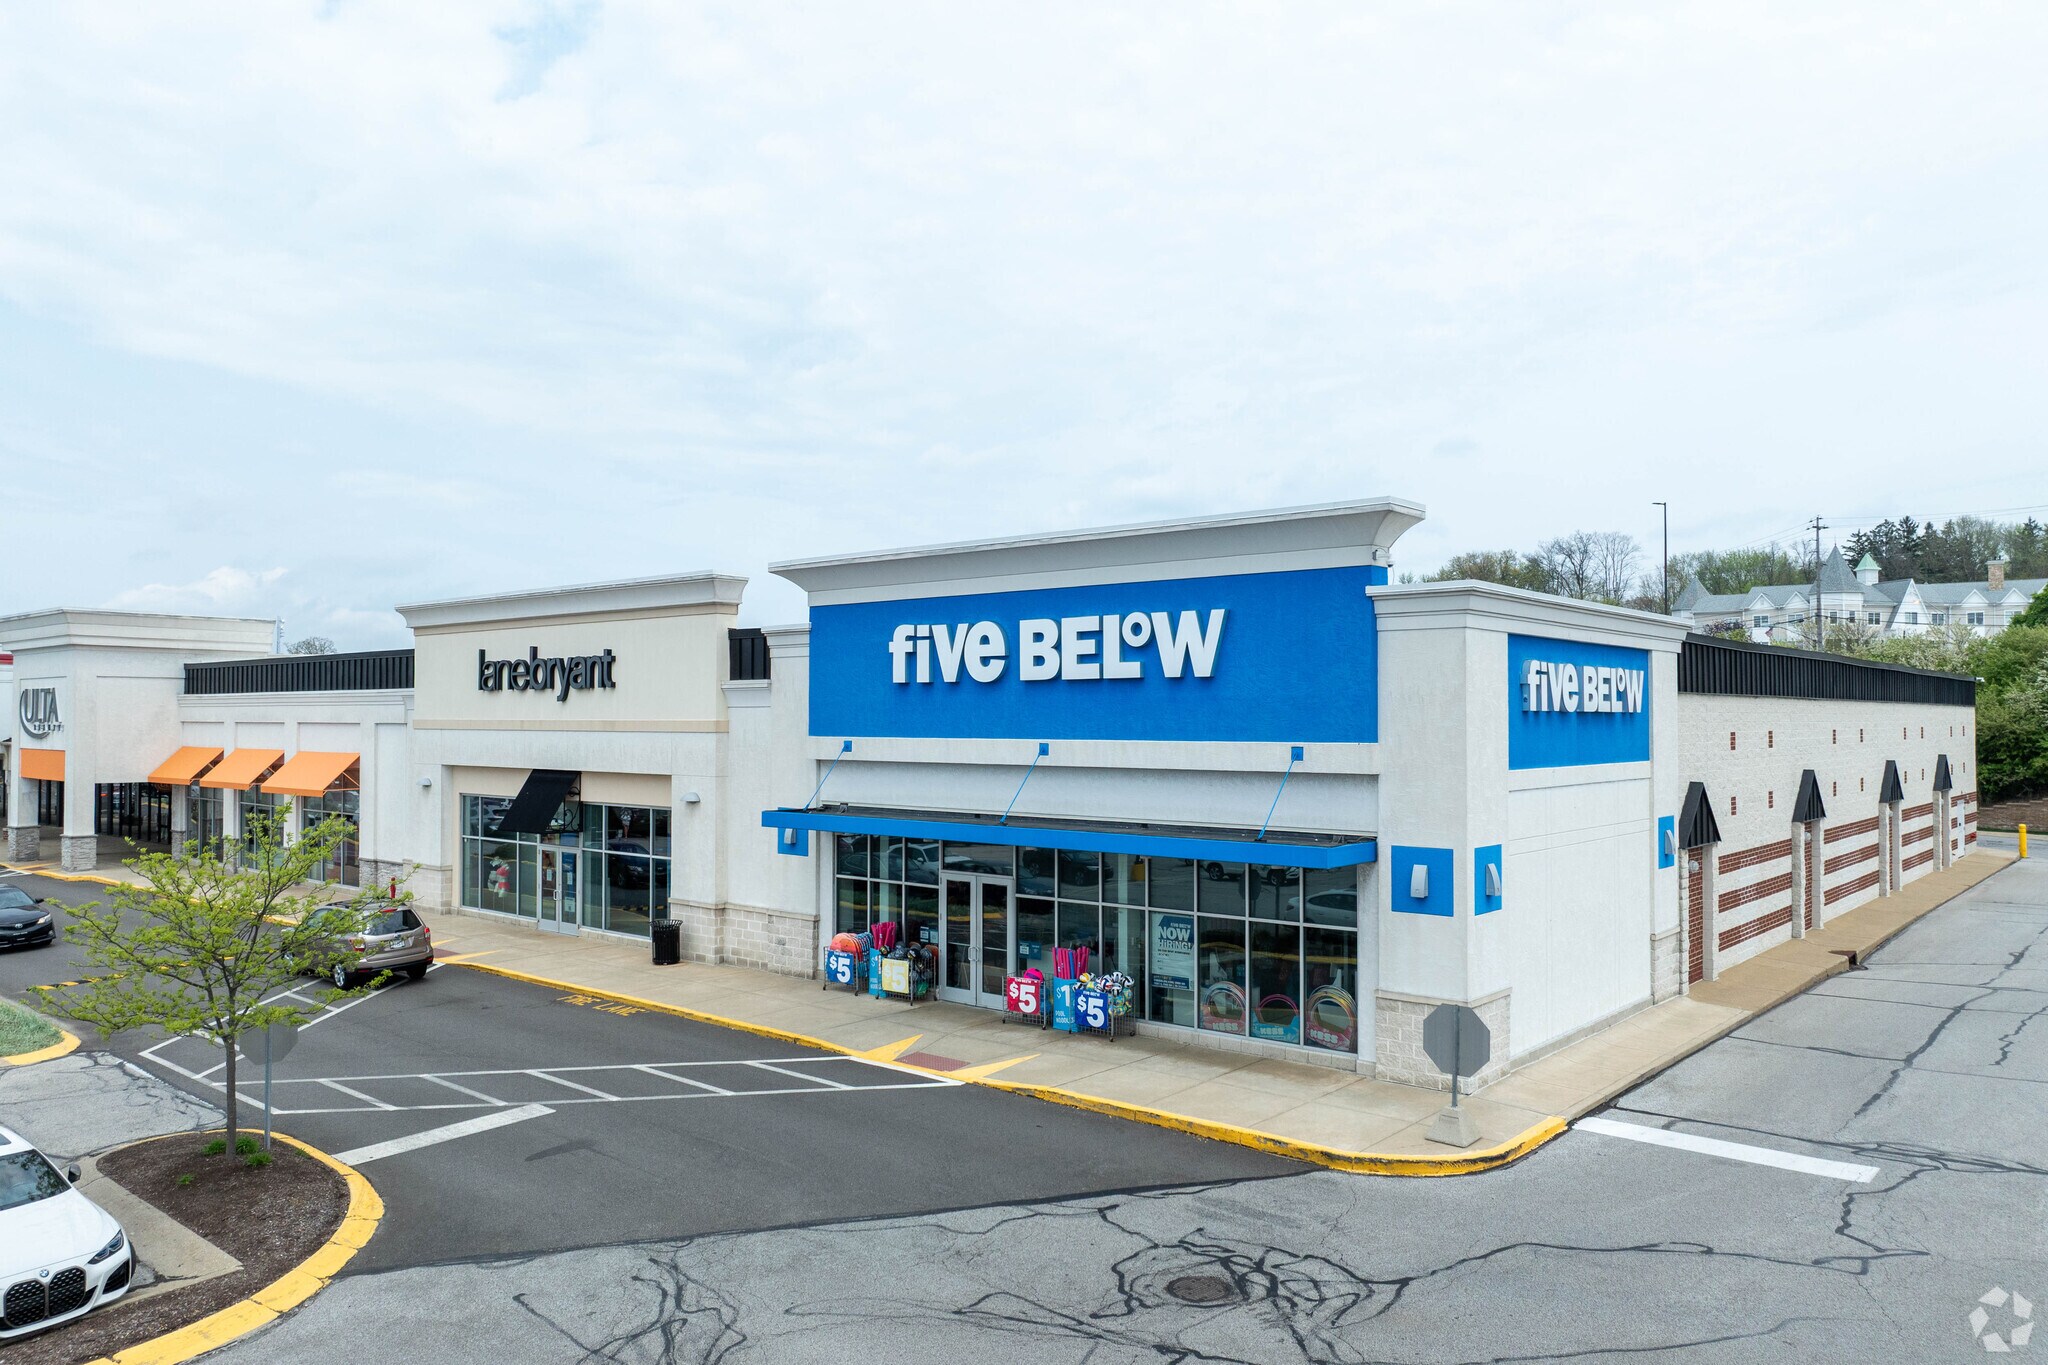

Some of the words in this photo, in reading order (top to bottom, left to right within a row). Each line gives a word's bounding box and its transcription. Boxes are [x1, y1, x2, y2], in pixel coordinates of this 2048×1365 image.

[888, 620, 1009, 684] five
[1019, 608, 1229, 681] BELOW
[478, 645, 616, 702] lanebryant
[1526, 659, 1580, 713] five
[1582, 664, 1645, 714] BELOW
[22, 687, 60, 724] ULTA
[1159, 926, 1190, 941] NOW
[829, 954, 851, 984] $5
[883, 963, 906, 991] $5
[1009, 982, 1036, 1013] $5
[1077, 994, 1104, 1027] $5
[1309, 1028, 1339, 1044] KESS
